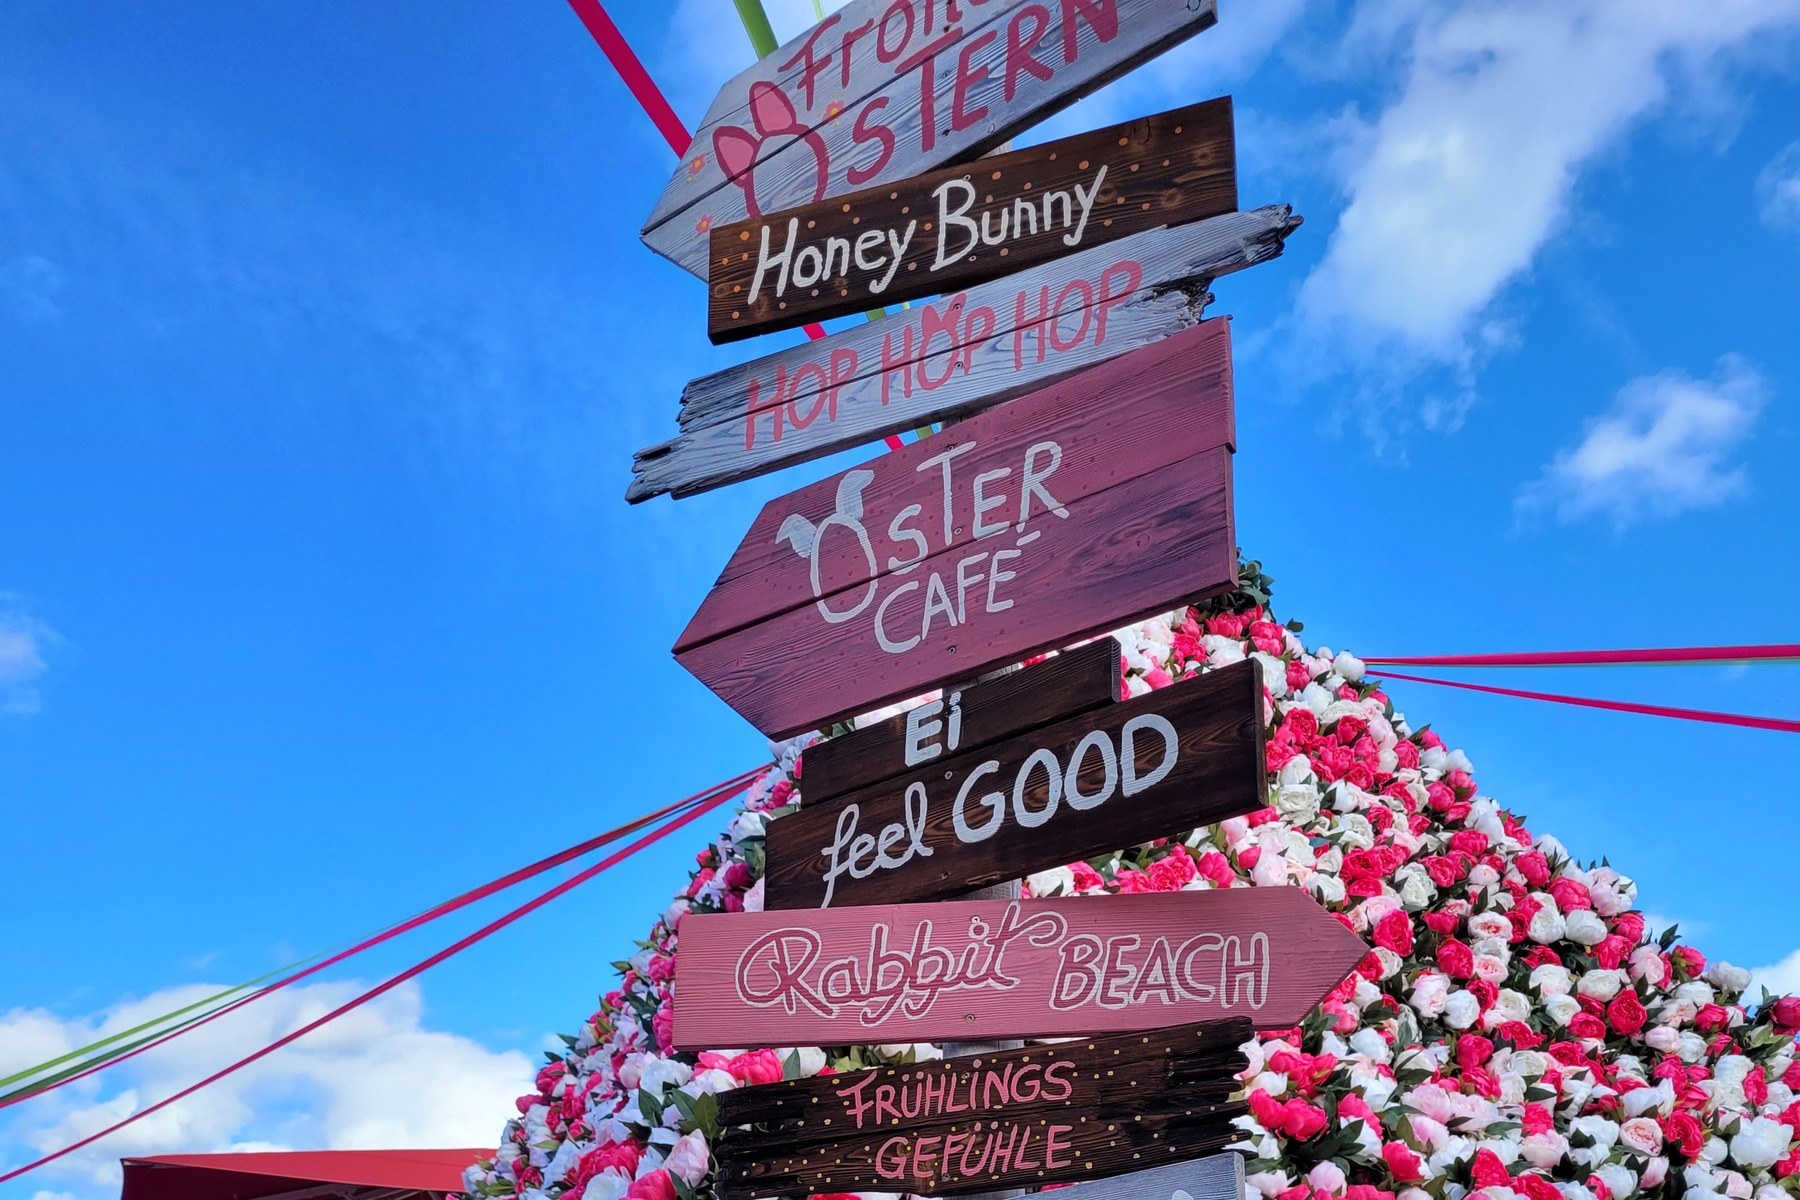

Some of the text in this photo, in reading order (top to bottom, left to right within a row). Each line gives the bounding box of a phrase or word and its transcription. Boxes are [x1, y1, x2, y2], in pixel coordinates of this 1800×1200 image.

[778, 0, 985, 111] Fro
[747, 166, 1107, 304] Honey Bunny
[745, 261, 1142, 450] HOP HOP HOP
[905, 691, 961, 767] Ei
[822, 714, 1178, 908] feel GOOD
[735, 900, 1269, 1027] Rabbit BEACH
[875, 1122, 1073, 1179] GEFÜHLE
